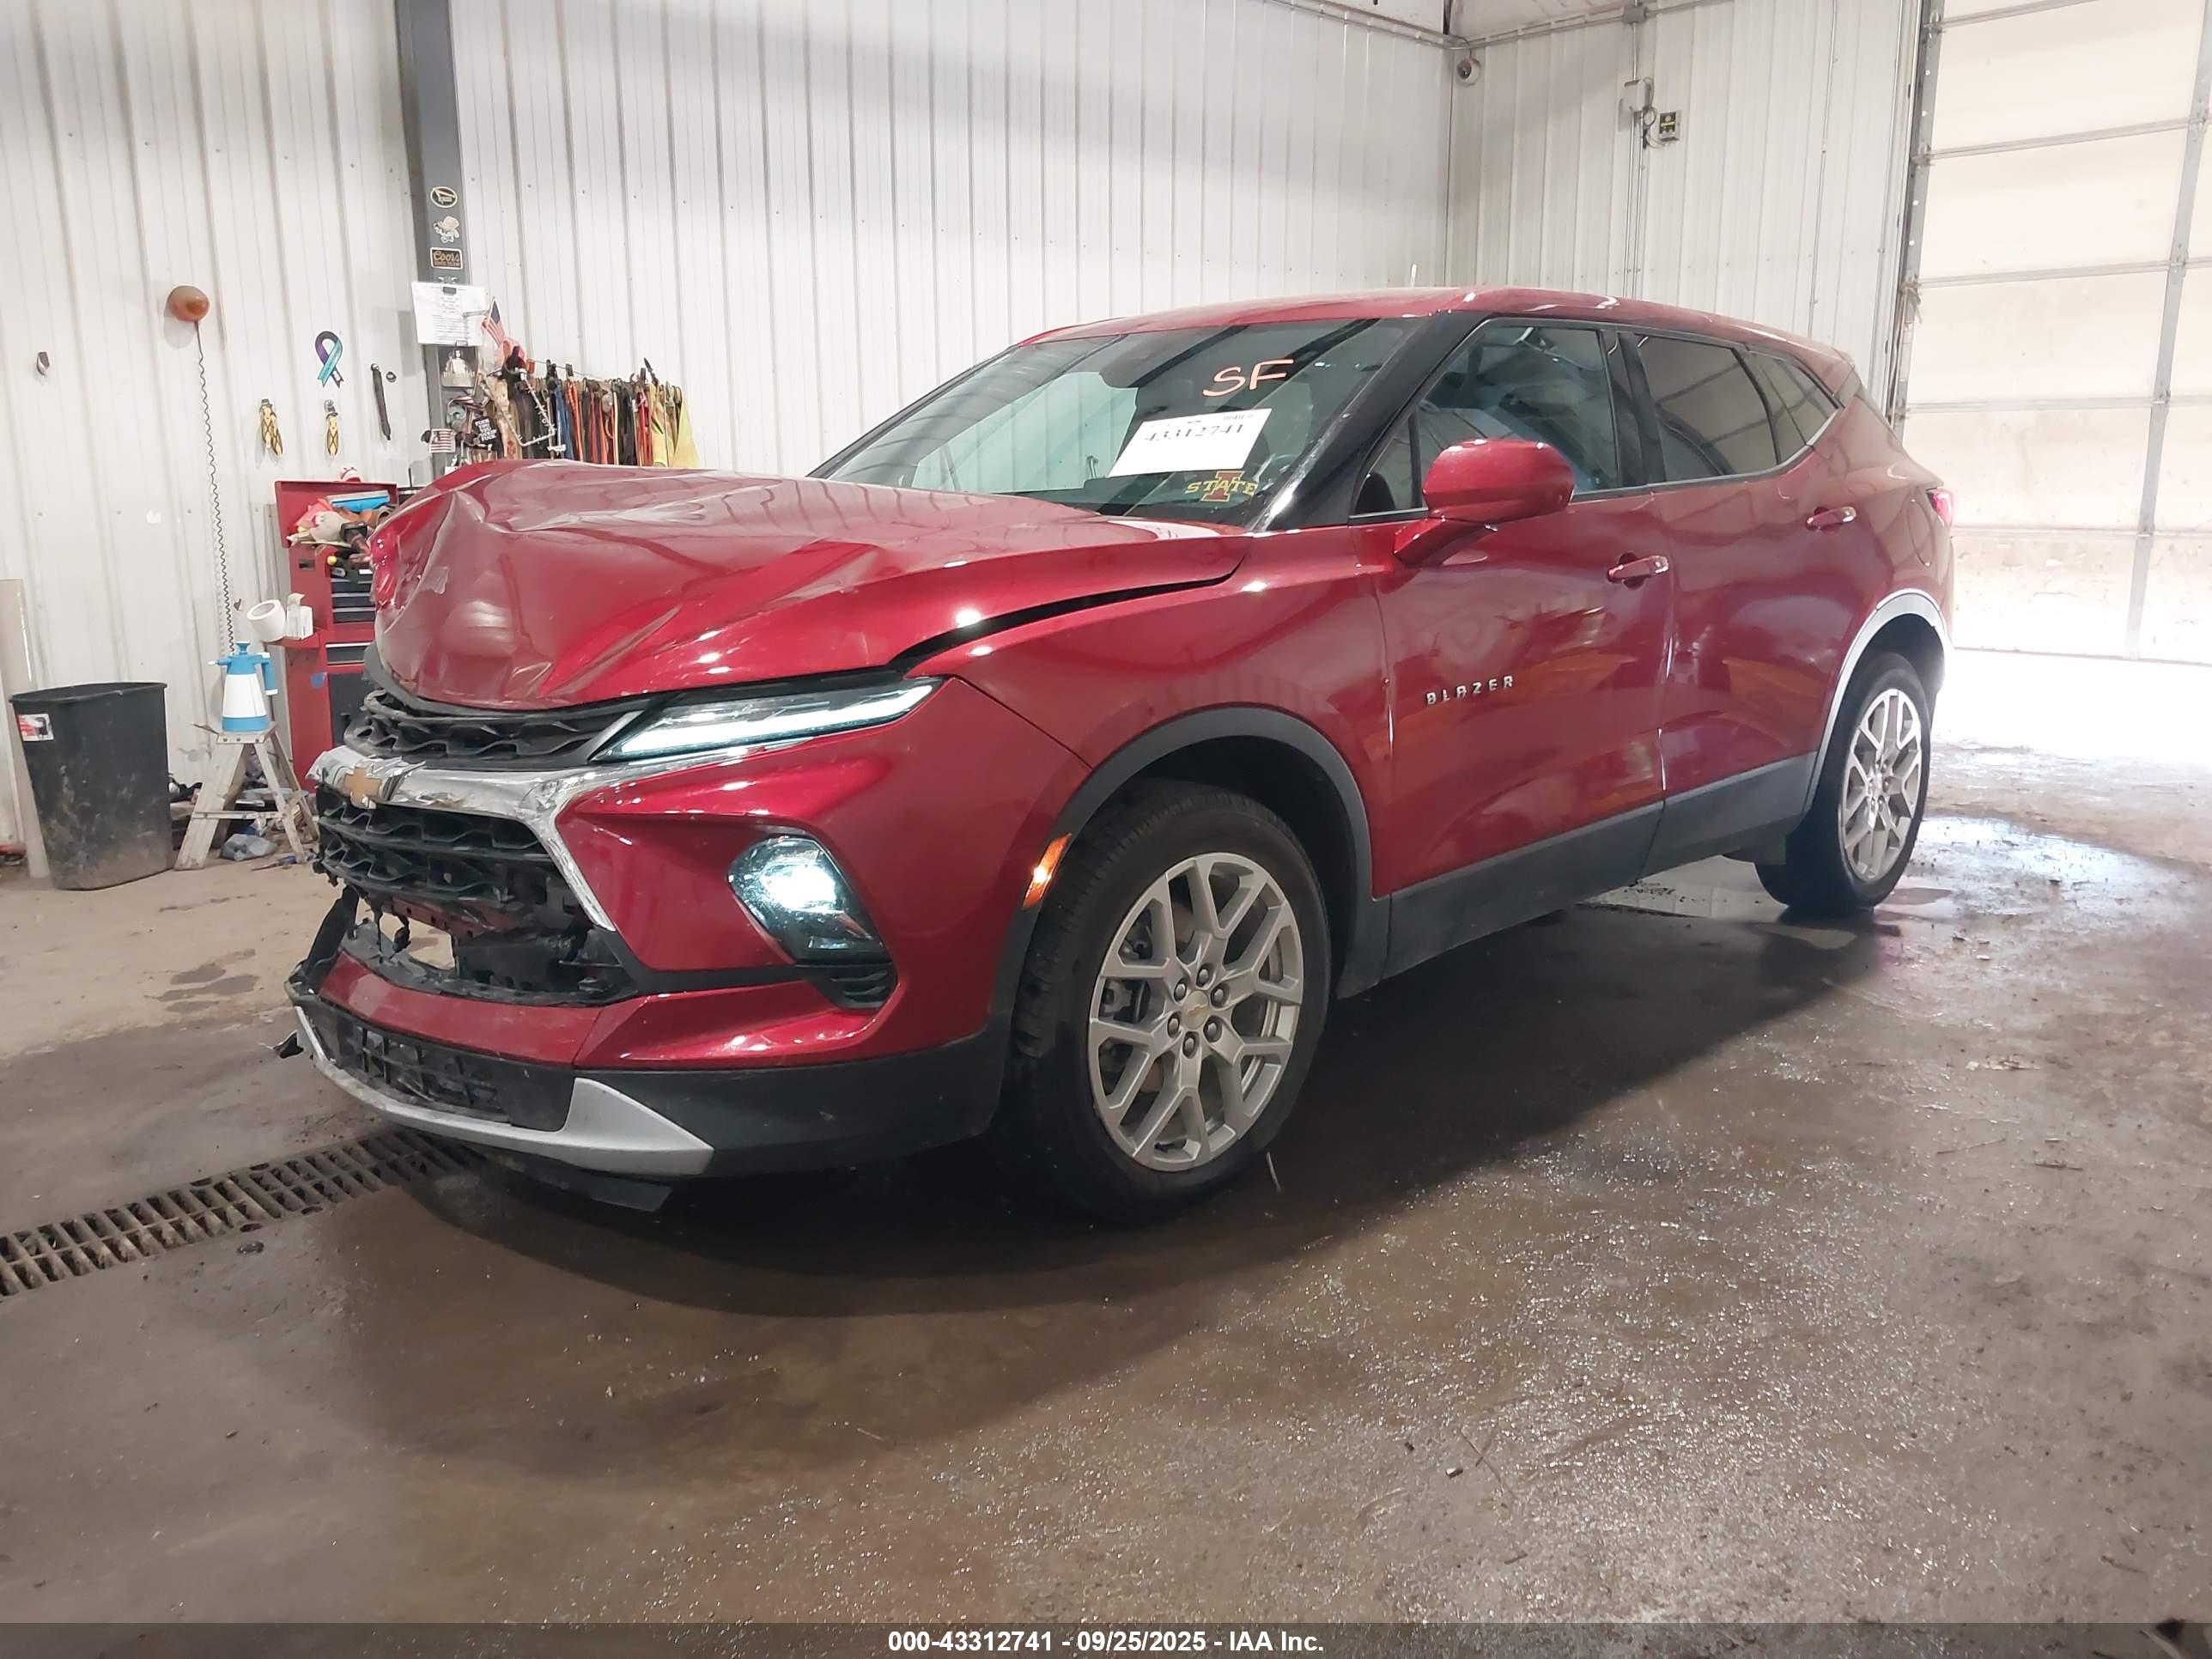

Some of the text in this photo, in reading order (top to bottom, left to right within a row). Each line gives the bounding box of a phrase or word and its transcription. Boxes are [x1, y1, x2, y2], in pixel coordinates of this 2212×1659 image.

[1202, 358, 1295, 398] SF
[1185, 479, 1260, 496] STATE
[1425, 675, 1514, 705] BLAZER
